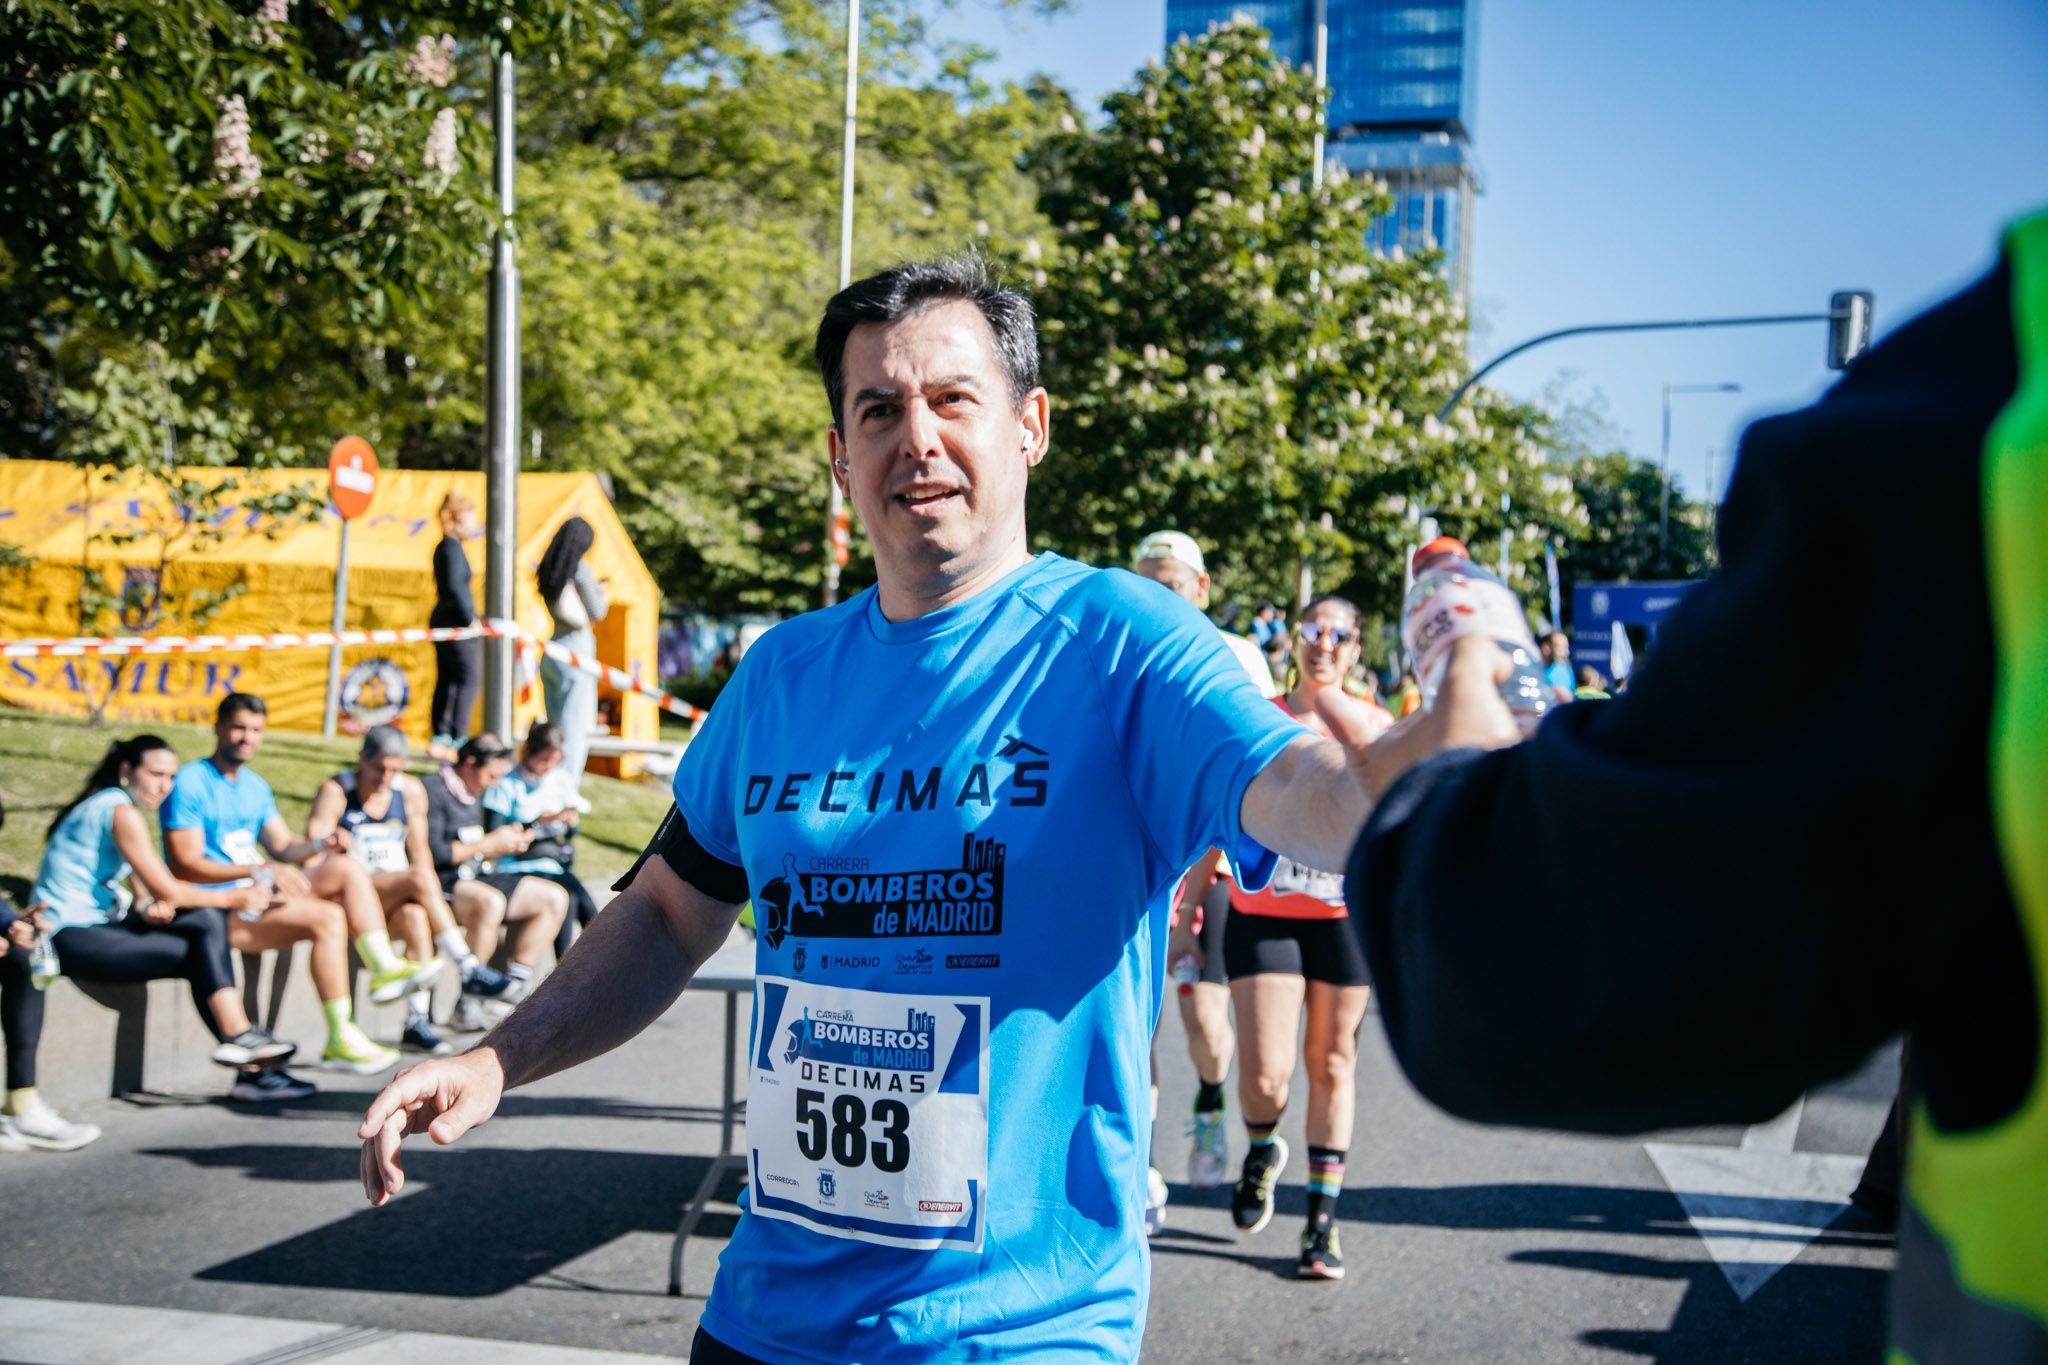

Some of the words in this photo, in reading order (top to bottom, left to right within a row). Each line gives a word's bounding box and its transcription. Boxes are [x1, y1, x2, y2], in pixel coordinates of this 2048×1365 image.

[743, 760, 1050, 816] DECIMAS
[809, 857, 870, 871] CARRERA
[811, 872, 994, 904] BOMBEROS
[873, 905, 899, 934] de
[906, 901, 994, 933] MADRID
[833, 956, 880, 969] MADRID
[816, 1009, 854, 1022] CARRERA
[814, 1022, 929, 1050] BOMBEROS
[852, 1046, 869, 1066] de
[873, 1048, 929, 1070] MADRID
[801, 1061, 925, 1093] DECIMAS
[796, 1087, 910, 1173] 583
